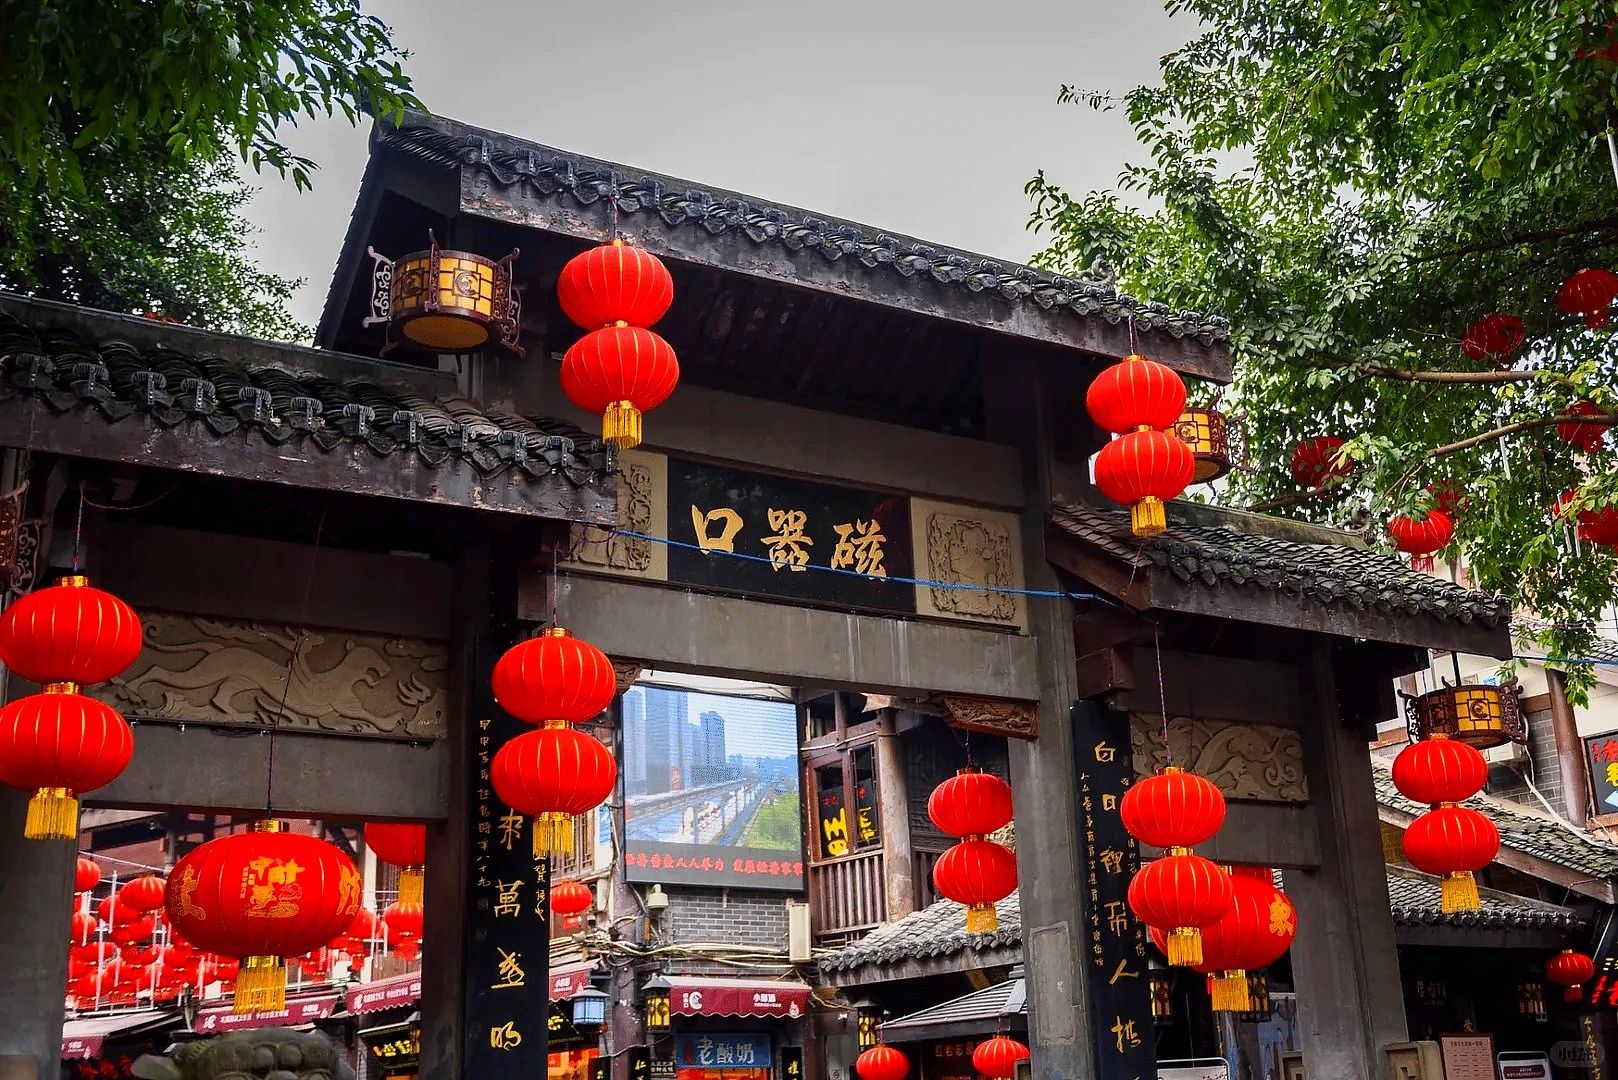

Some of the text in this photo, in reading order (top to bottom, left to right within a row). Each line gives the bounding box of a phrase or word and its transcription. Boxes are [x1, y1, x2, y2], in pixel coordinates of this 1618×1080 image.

[691, 504, 887, 581] 磁器口
[697, 1036, 755, 1066] 老酸奶
